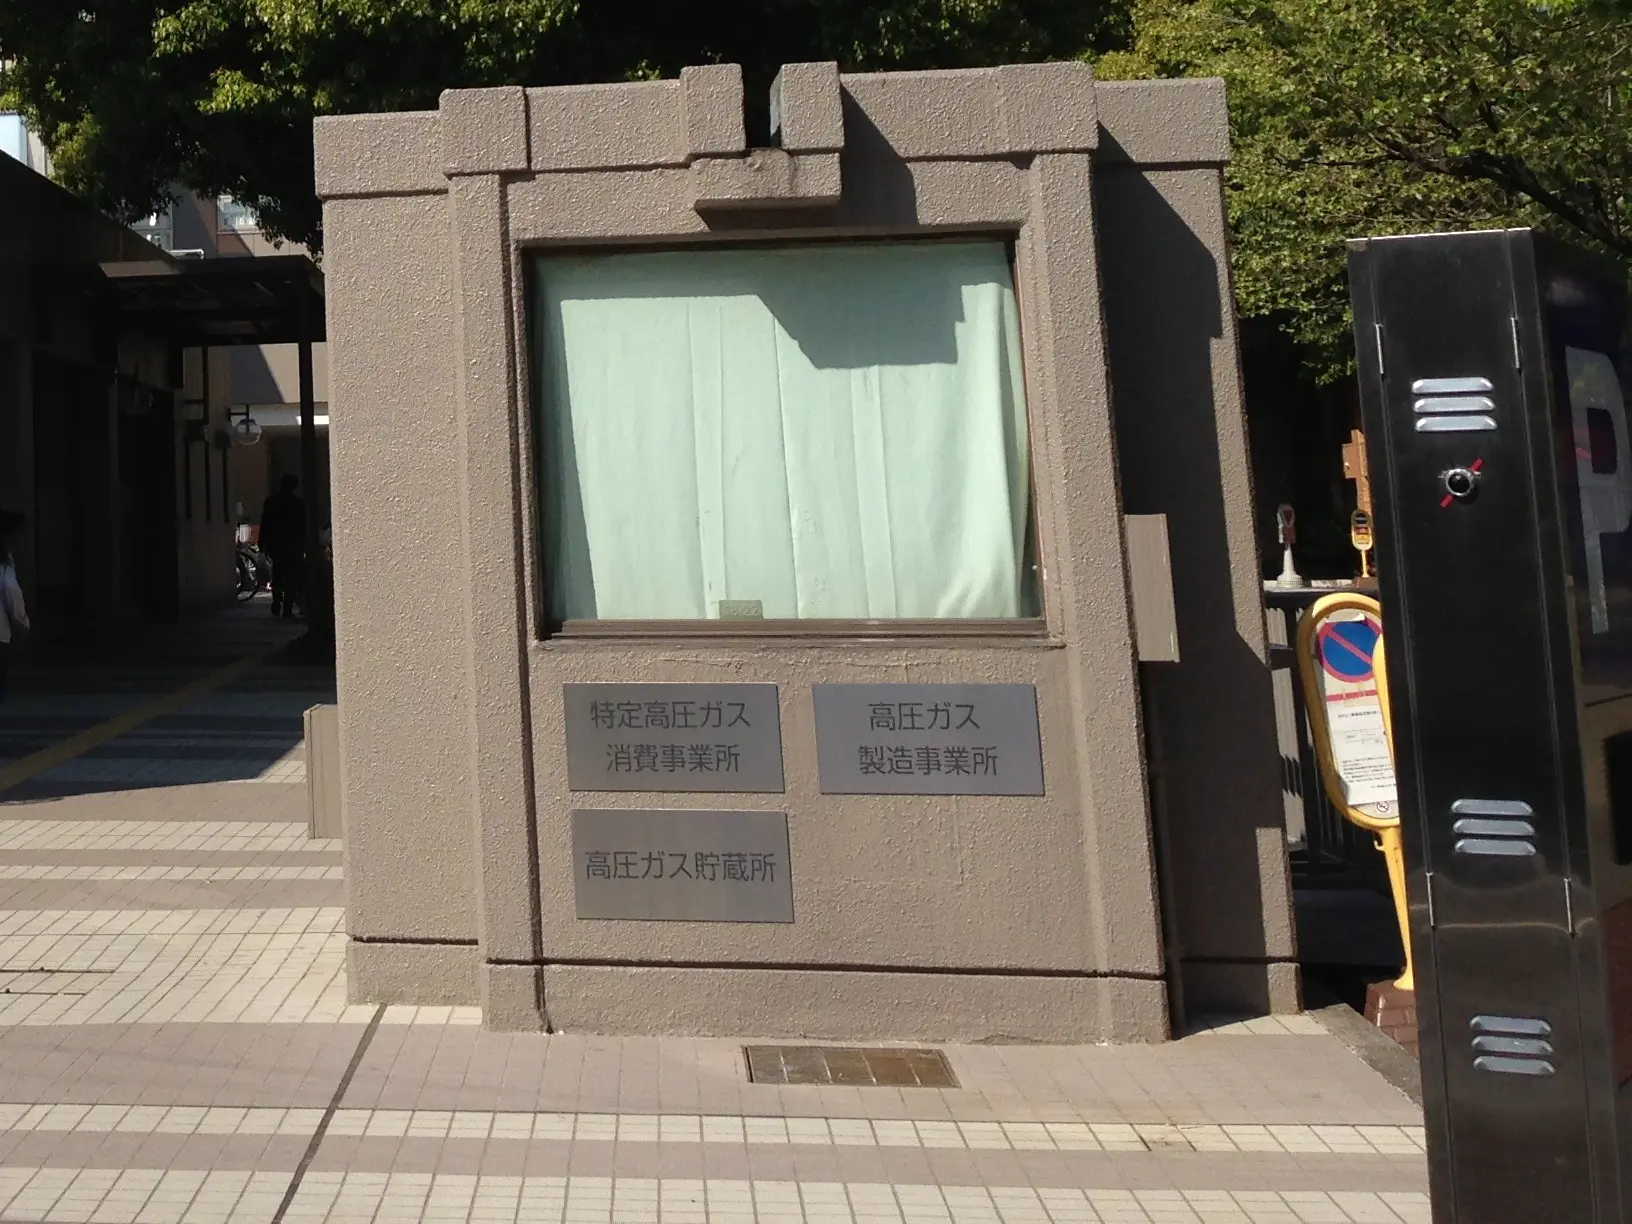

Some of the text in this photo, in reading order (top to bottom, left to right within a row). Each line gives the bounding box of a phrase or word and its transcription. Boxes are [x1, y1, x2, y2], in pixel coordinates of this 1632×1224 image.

[590, 699, 752, 730] 特定高圧ガス
[868, 701, 981, 731] 高圧ガス
[606, 743, 741, 773] 消費事業所
[858, 745, 999, 776] 製造事業所
[584, 849, 777, 882] 高圧ガス貯蔵所
